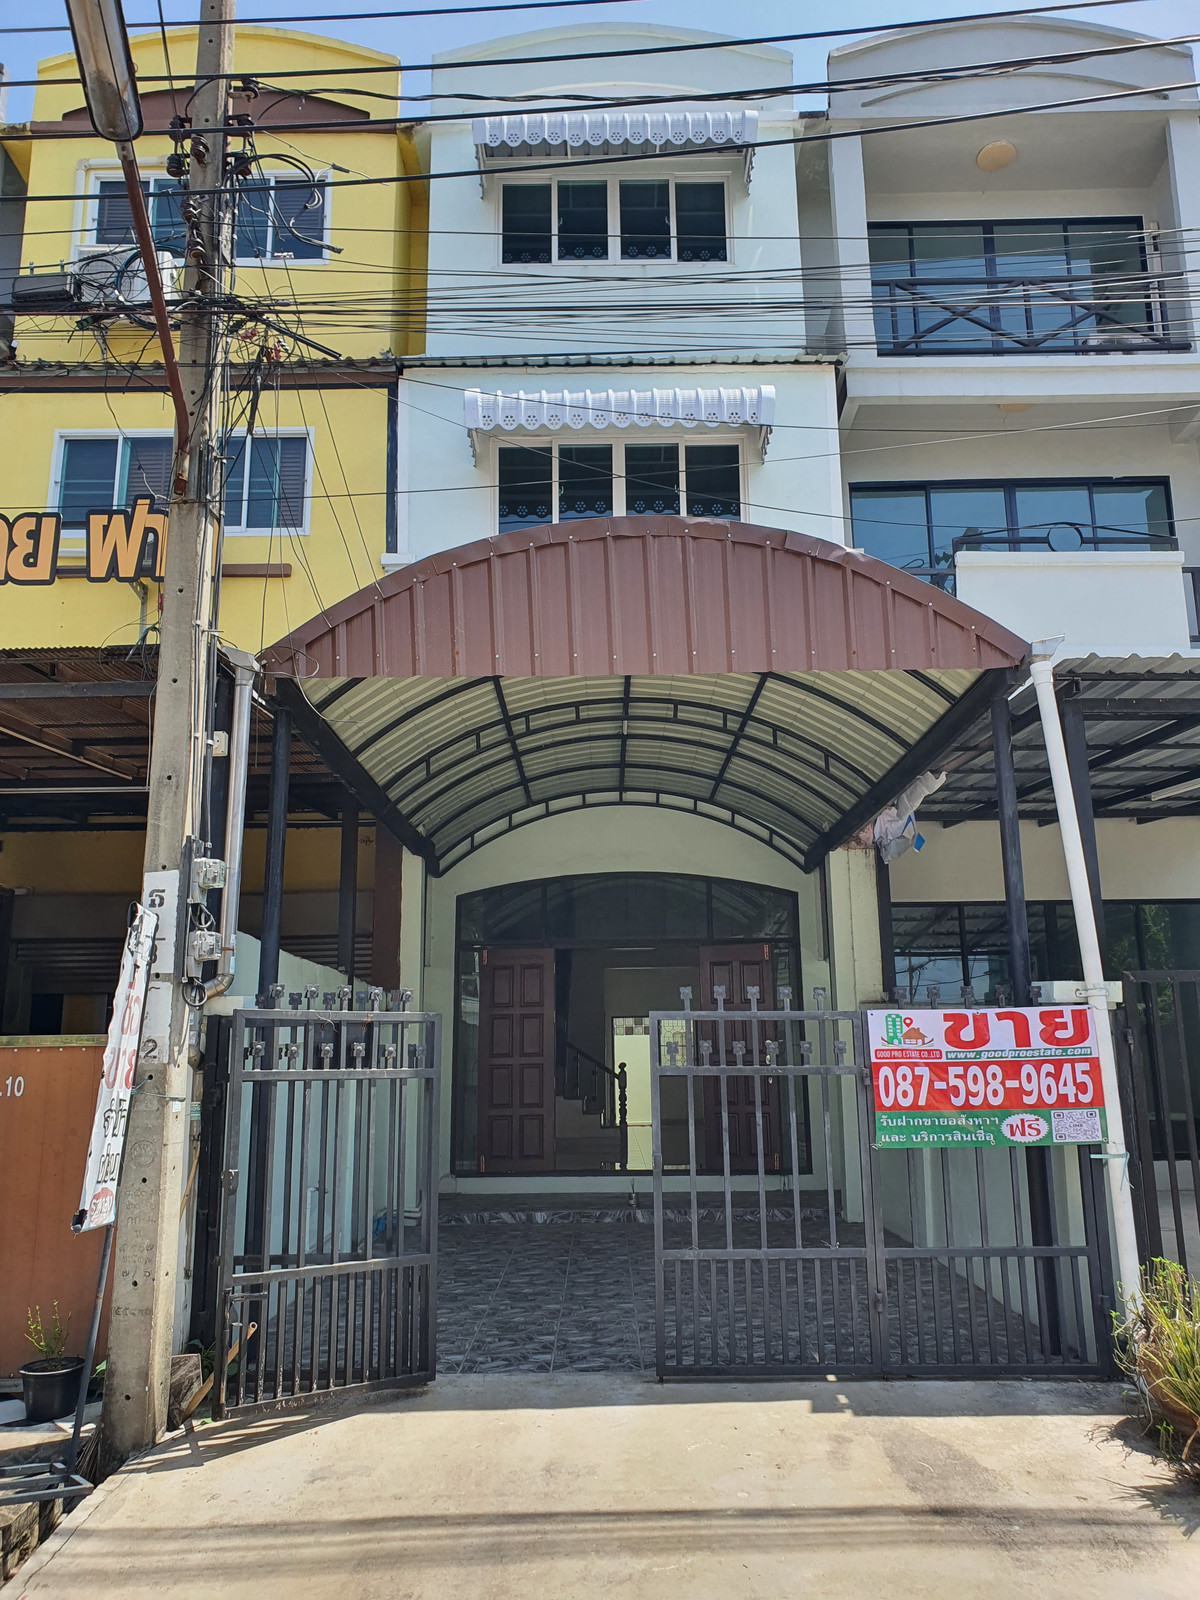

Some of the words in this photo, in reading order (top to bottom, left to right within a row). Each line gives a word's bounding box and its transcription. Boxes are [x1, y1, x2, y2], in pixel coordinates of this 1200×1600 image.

[943, 1009, 1090, 1050] ขาย
[876, 1050, 890, 1058] GOOD
[891, 1050, 902, 1058] PRO
[903, 1050, 920, 1058] ESTATE
[947, 1047, 1091, 1060] www.goodproestate.com
[878, 1062, 1094, 1107] 087-598-9645
[881, 1133, 906, 1142] และ
[911, 1126, 994, 1142] บริการสินเชื่อ
[1006, 1118, 1041, 1137] ฟรี
